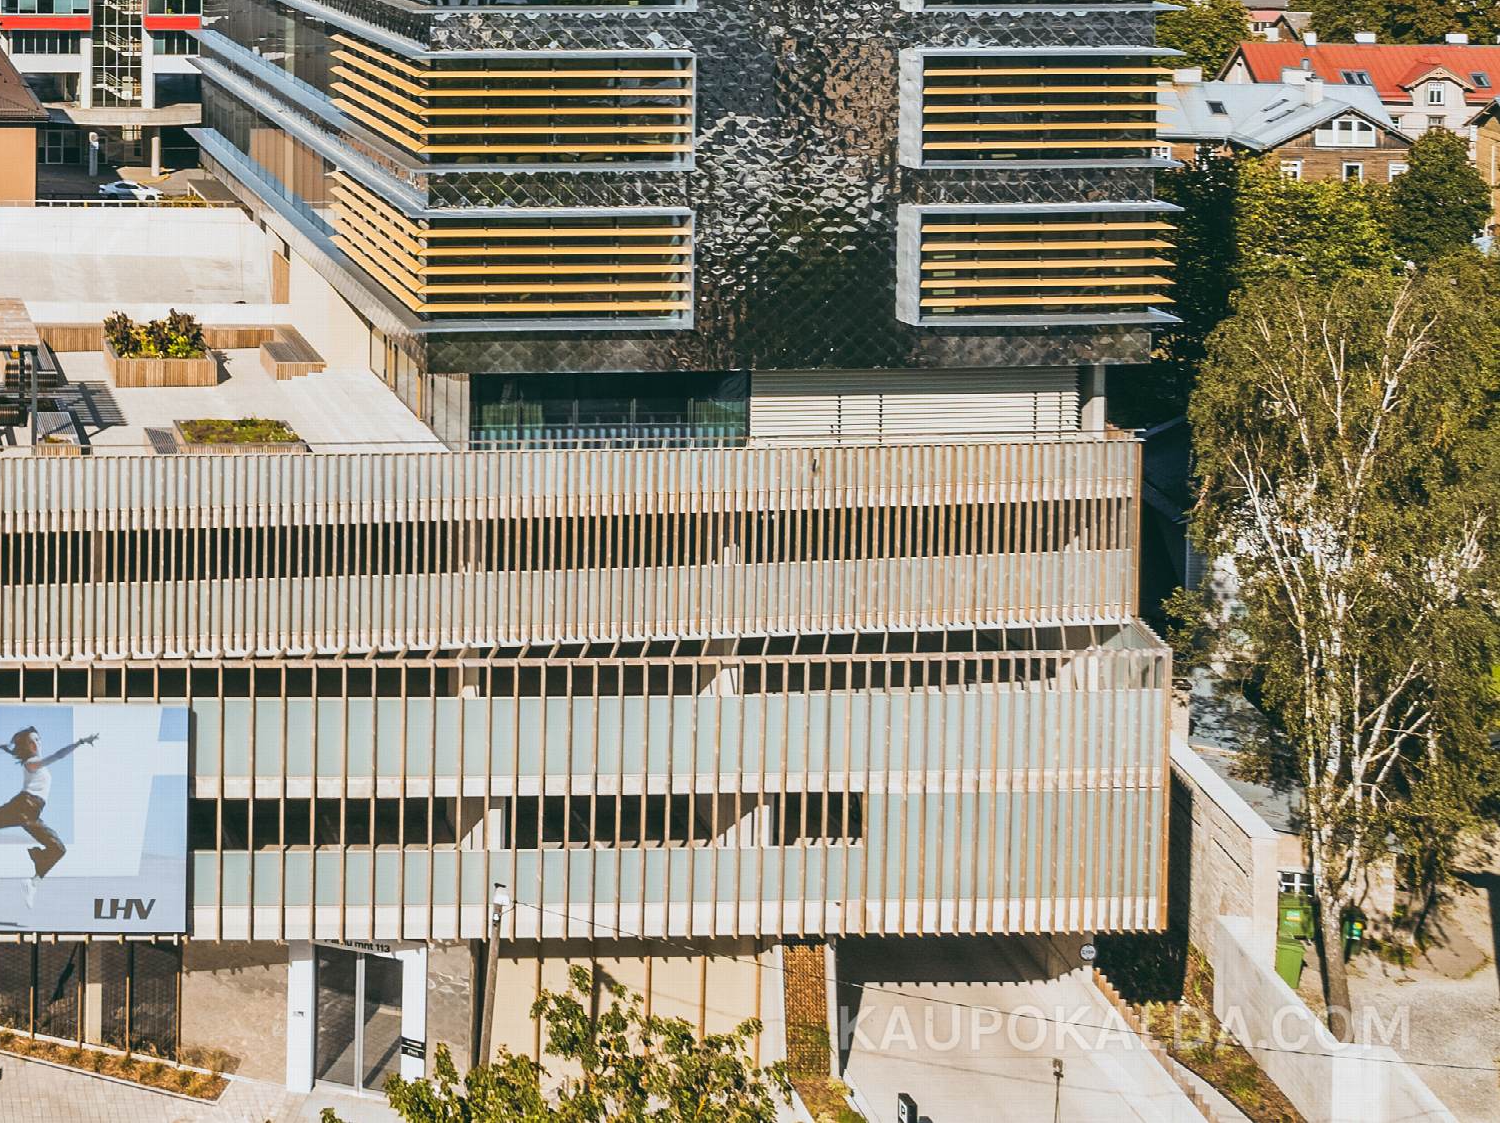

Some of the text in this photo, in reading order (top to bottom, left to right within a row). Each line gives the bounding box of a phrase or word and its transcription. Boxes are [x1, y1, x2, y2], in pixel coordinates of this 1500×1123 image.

[94, 898, 156, 920] LHV
[355, 941, 373, 950] mnt
[375, 944, 390, 953] 113
